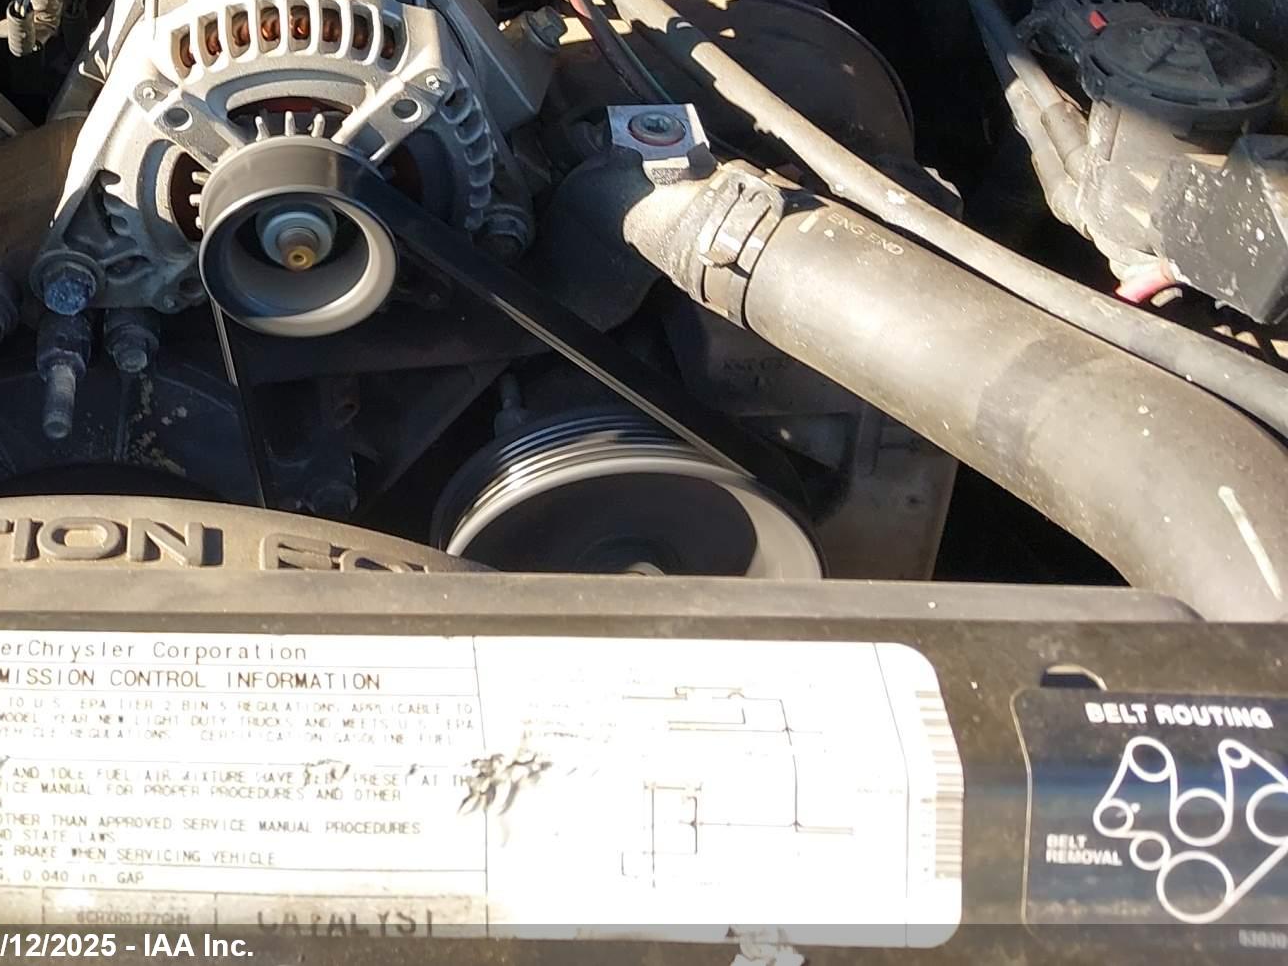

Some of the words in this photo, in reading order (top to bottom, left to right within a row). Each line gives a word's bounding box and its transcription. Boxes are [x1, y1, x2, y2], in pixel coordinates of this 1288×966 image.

[827, 212, 865, 235] ENG
[866, 232, 905, 255] END
[152, 641, 308, 665] Corporation
[109, 670, 207, 689] CONTROL
[226, 672, 381, 691] INFORMATION
[181, 700, 209, 712] BIN
[190, 715, 228, 727] DUTY
[305, 717, 332, 729] AND
[1085, 702, 1149, 724] BELT
[1155, 705, 1274, 729] ROUTING
[421, 775, 439, 787] AT
[450, 775, 480, 788] TH
[40, 782, 92, 795] MANUAL
[143, 784, 200, 797] PROPER
[210, 785, 305, 801] PROCEDURES
[315, 787, 344, 800] AND
[51, 814, 88, 827] THAN
[98, 815, 173, 829] APPROVED
[182, 817, 250, 831] SERVICE
[258, 820, 312, 833] MANUAL
[324, 820, 421, 835] PROCEDURES
[23, 829, 68, 842] STATE
[1046, 834, 1089, 849] BELT
[14, 844, 58, 859] BRAKE
[71, 848, 106, 860] WHEN
[116, 848, 201, 863] SERVICING
[211, 850, 277, 866] VEHICLE
[1046, 849, 1123, 867] REMOVAL
[116, 871, 145, 884] GAP
